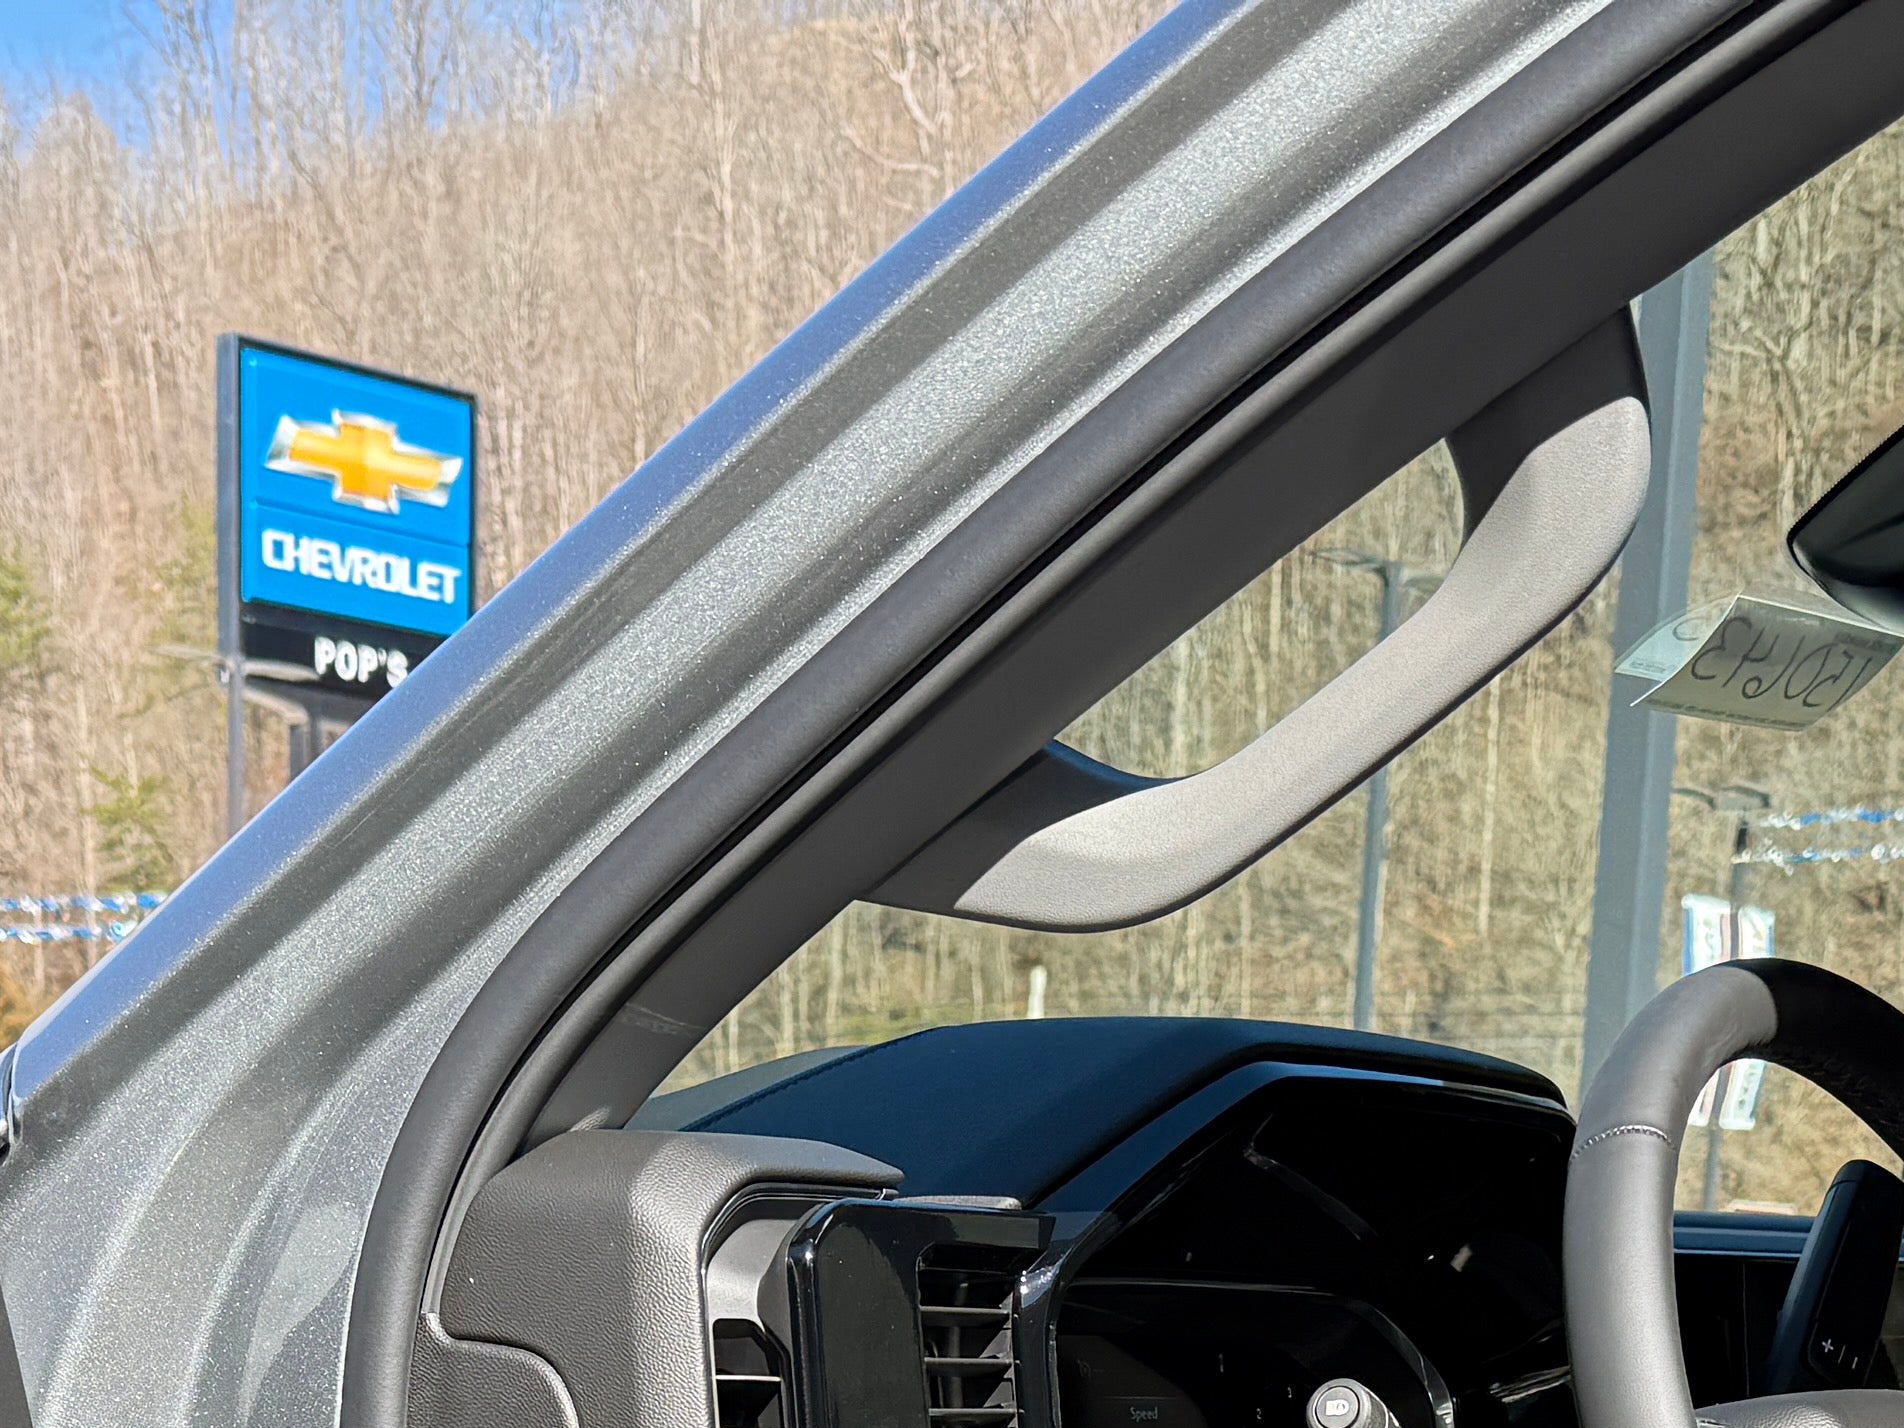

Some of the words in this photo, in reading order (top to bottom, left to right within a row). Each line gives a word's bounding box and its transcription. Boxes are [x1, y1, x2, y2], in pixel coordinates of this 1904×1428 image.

[261, 527, 461, 605] CHEVROLET
[314, 635, 409, 688] POP'S
[1129, 1406, 1159, 1423] Speed
